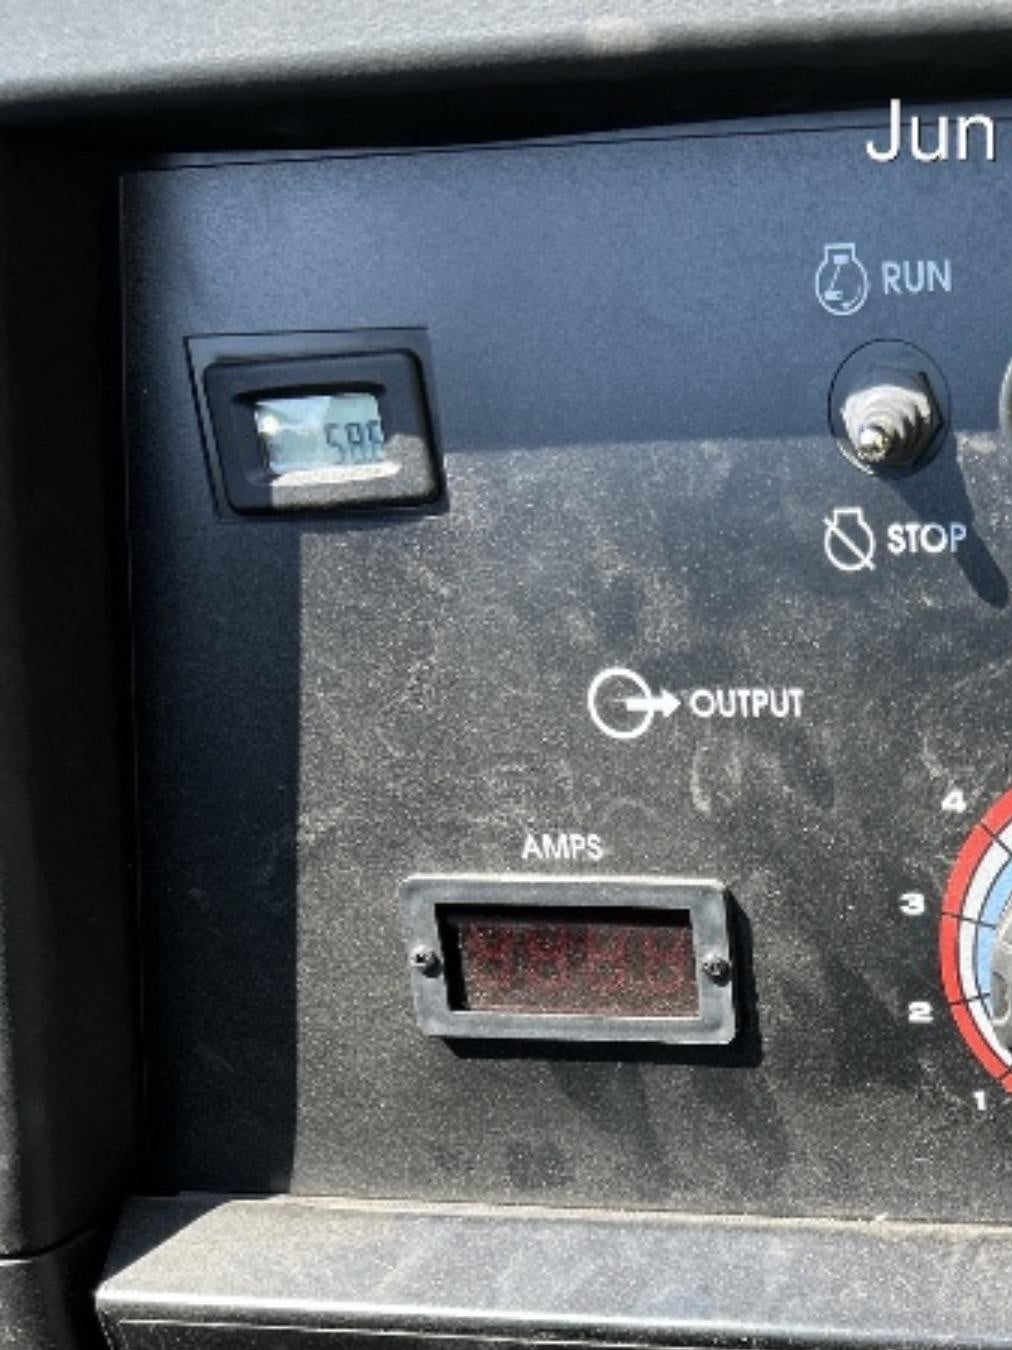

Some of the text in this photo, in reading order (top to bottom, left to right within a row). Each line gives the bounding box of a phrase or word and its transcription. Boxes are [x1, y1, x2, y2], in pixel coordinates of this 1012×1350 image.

[882, 260, 953, 294] RUN
[887, 523, 968, 556] STOP
[689, 687, 804, 719] OUTPUT
[942, 790, 967, 815] 4
[521, 834, 604, 862] AMPS
[899, 892, 926, 915] 3
[907, 1001, 933, 1024] 2
[974, 1091, 988, 1112] 1
